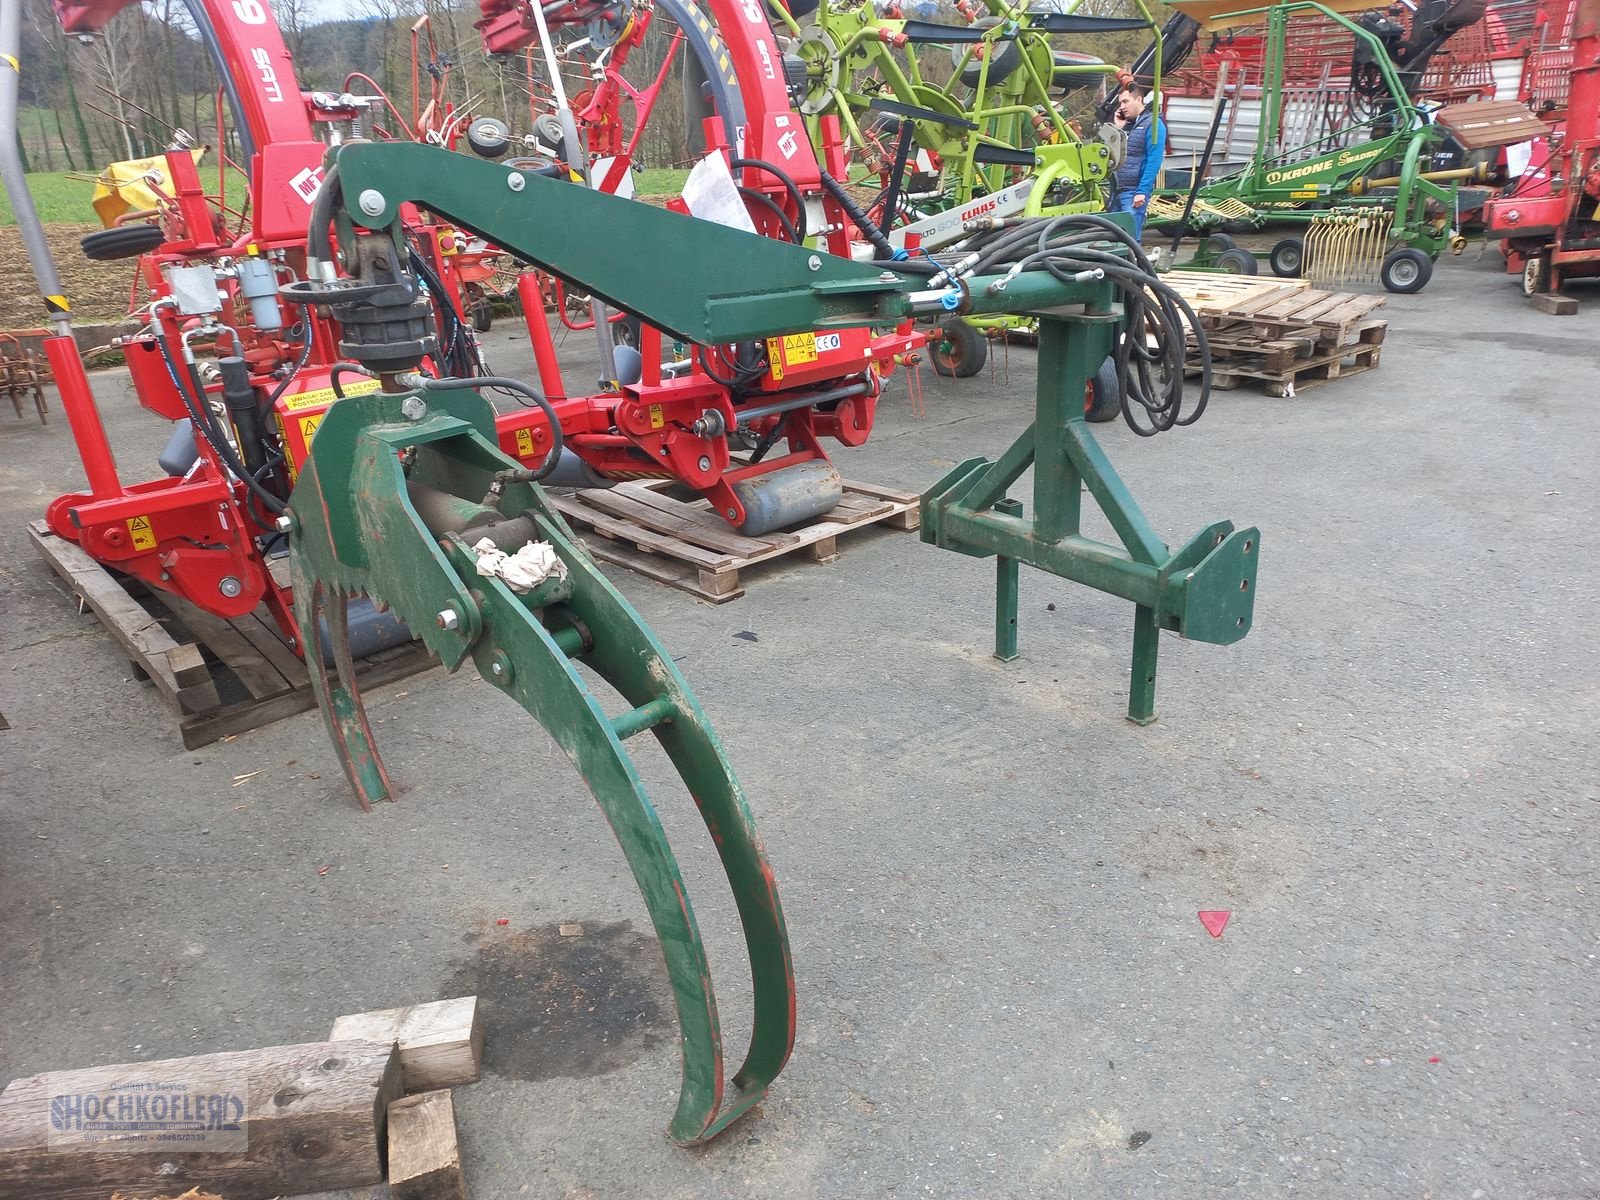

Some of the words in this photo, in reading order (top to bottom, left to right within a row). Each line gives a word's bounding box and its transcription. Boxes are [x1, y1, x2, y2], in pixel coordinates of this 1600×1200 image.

[250, 47, 284, 103] SATI
[1282, 159, 1334, 182] KRONE
[961, 200, 996, 221] CLAAS
